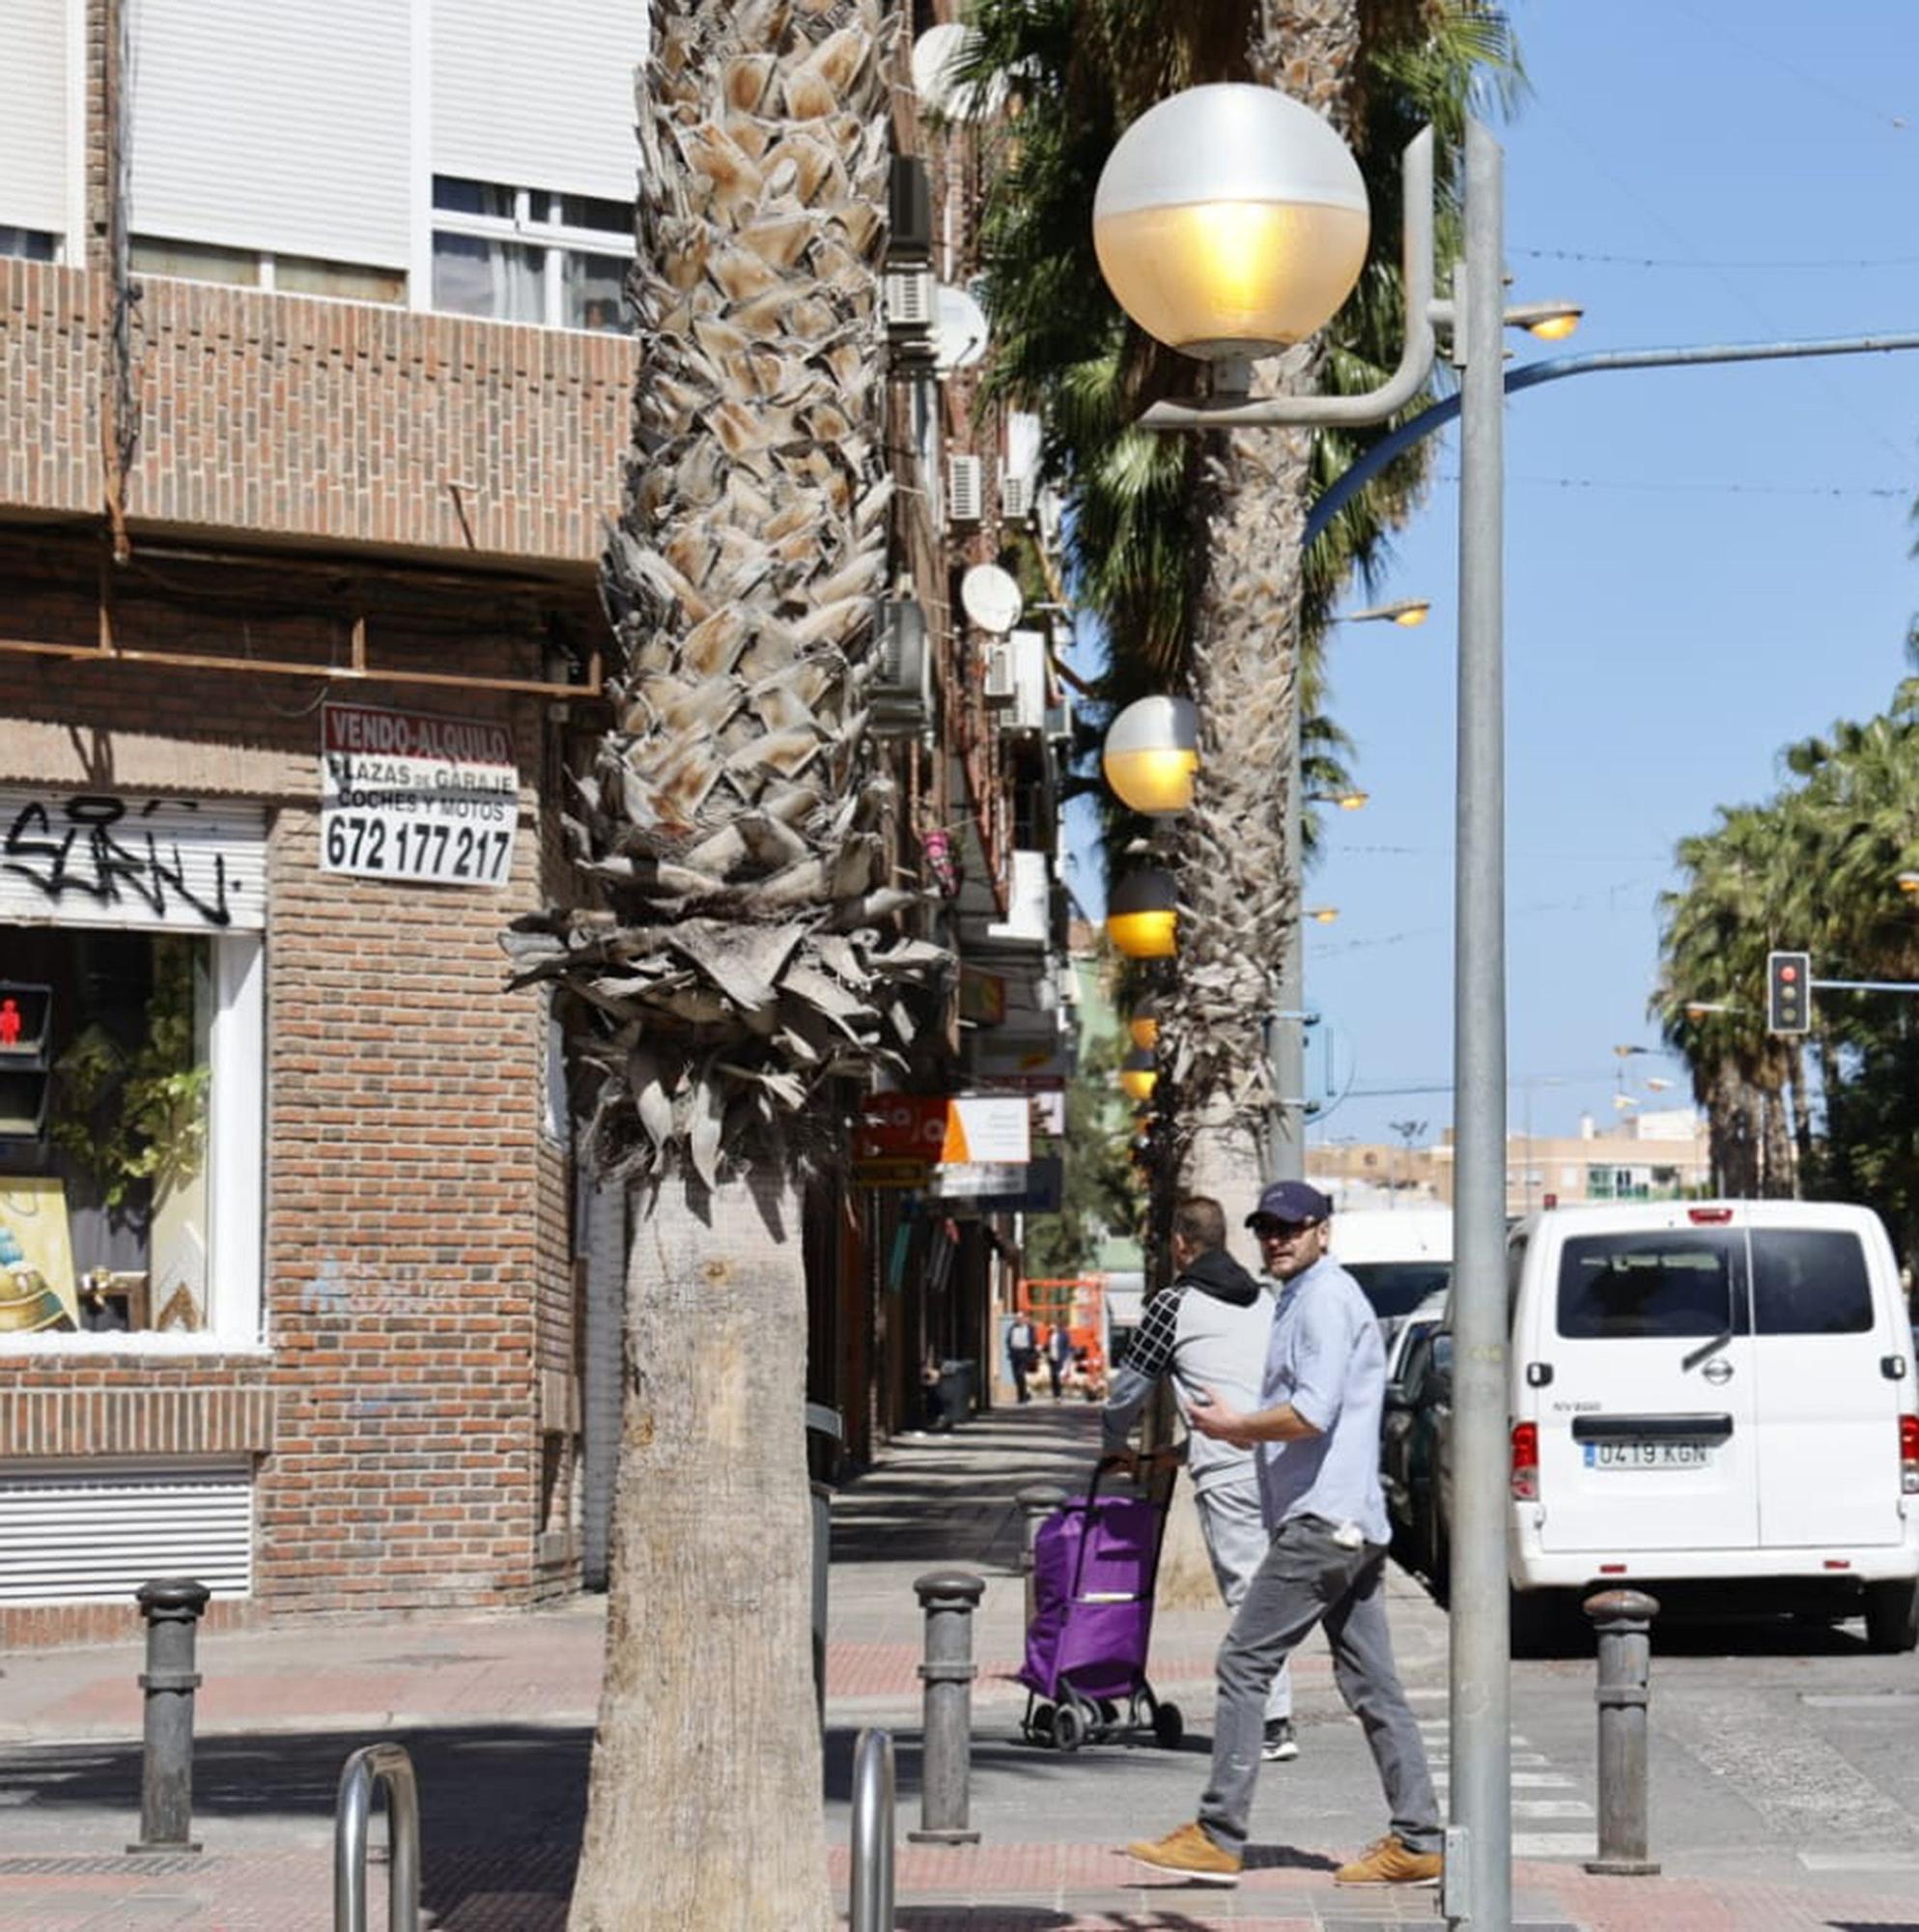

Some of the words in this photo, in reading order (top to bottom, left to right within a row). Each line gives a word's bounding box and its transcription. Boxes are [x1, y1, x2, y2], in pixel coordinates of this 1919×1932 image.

[332, 710, 507, 761] VENDO-ALQUILO
[328, 755, 410, 784] PLAZAS
[435, 769, 511, 795] GARAJE
[339, 788, 417, 812] COCHES
[425, 794, 436, 813] Y
[440, 798, 504, 821] MOTOS
[327, 814, 386, 868] 672
[396, 822, 449, 874] 177
[453, 827, 510, 879] 217
[1599, 1442, 1656, 1463] 0419
[1663, 1442, 1707, 1463] KGN
